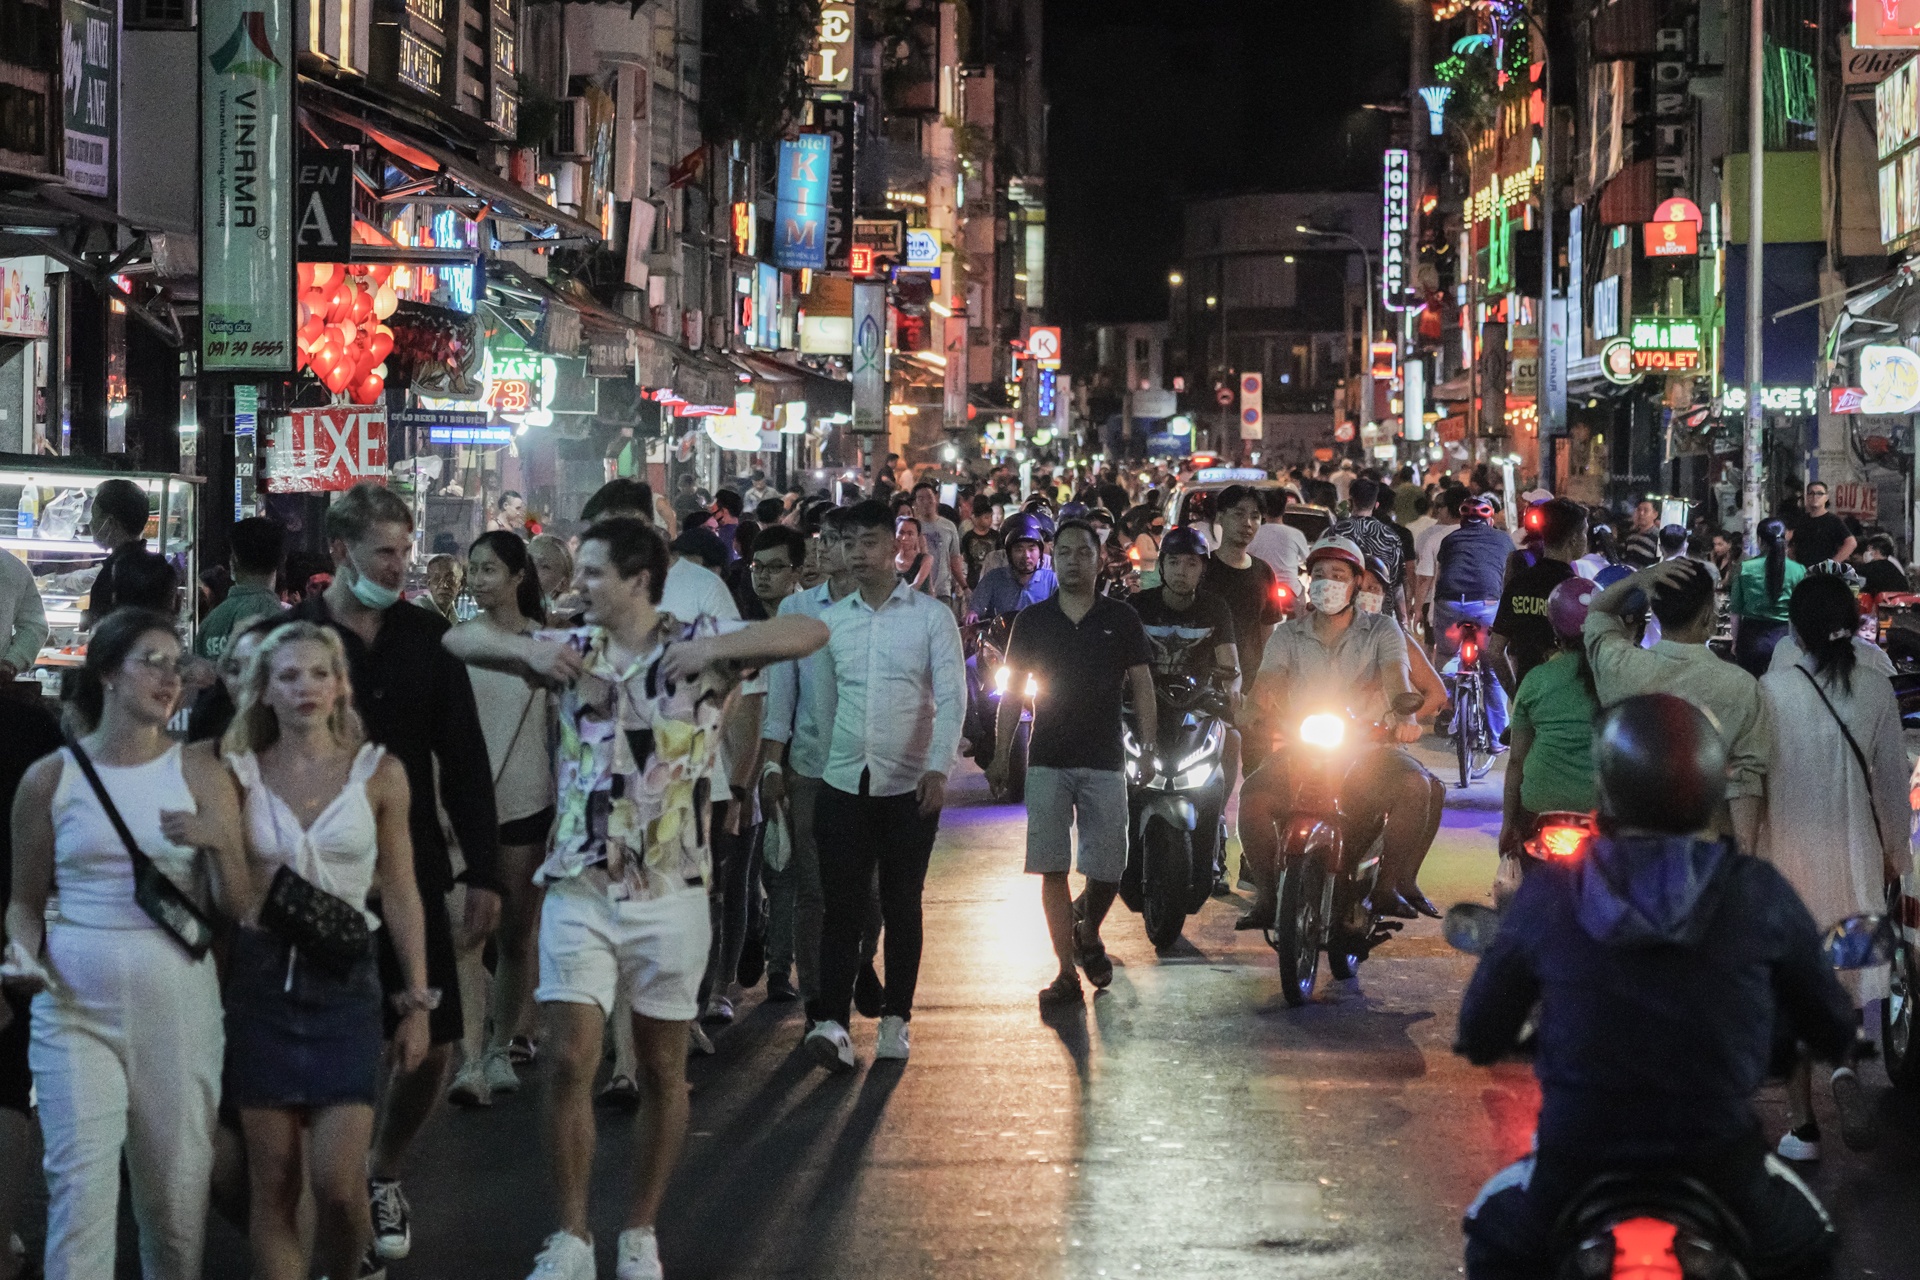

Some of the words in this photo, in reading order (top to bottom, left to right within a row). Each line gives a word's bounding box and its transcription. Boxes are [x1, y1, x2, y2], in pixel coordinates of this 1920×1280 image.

[819, 0, 850, 81] EL
[234, 89, 257, 228] VINAMA
[784, 151, 819, 249] KIM
[1635, 352, 1698, 367] VIOLET
